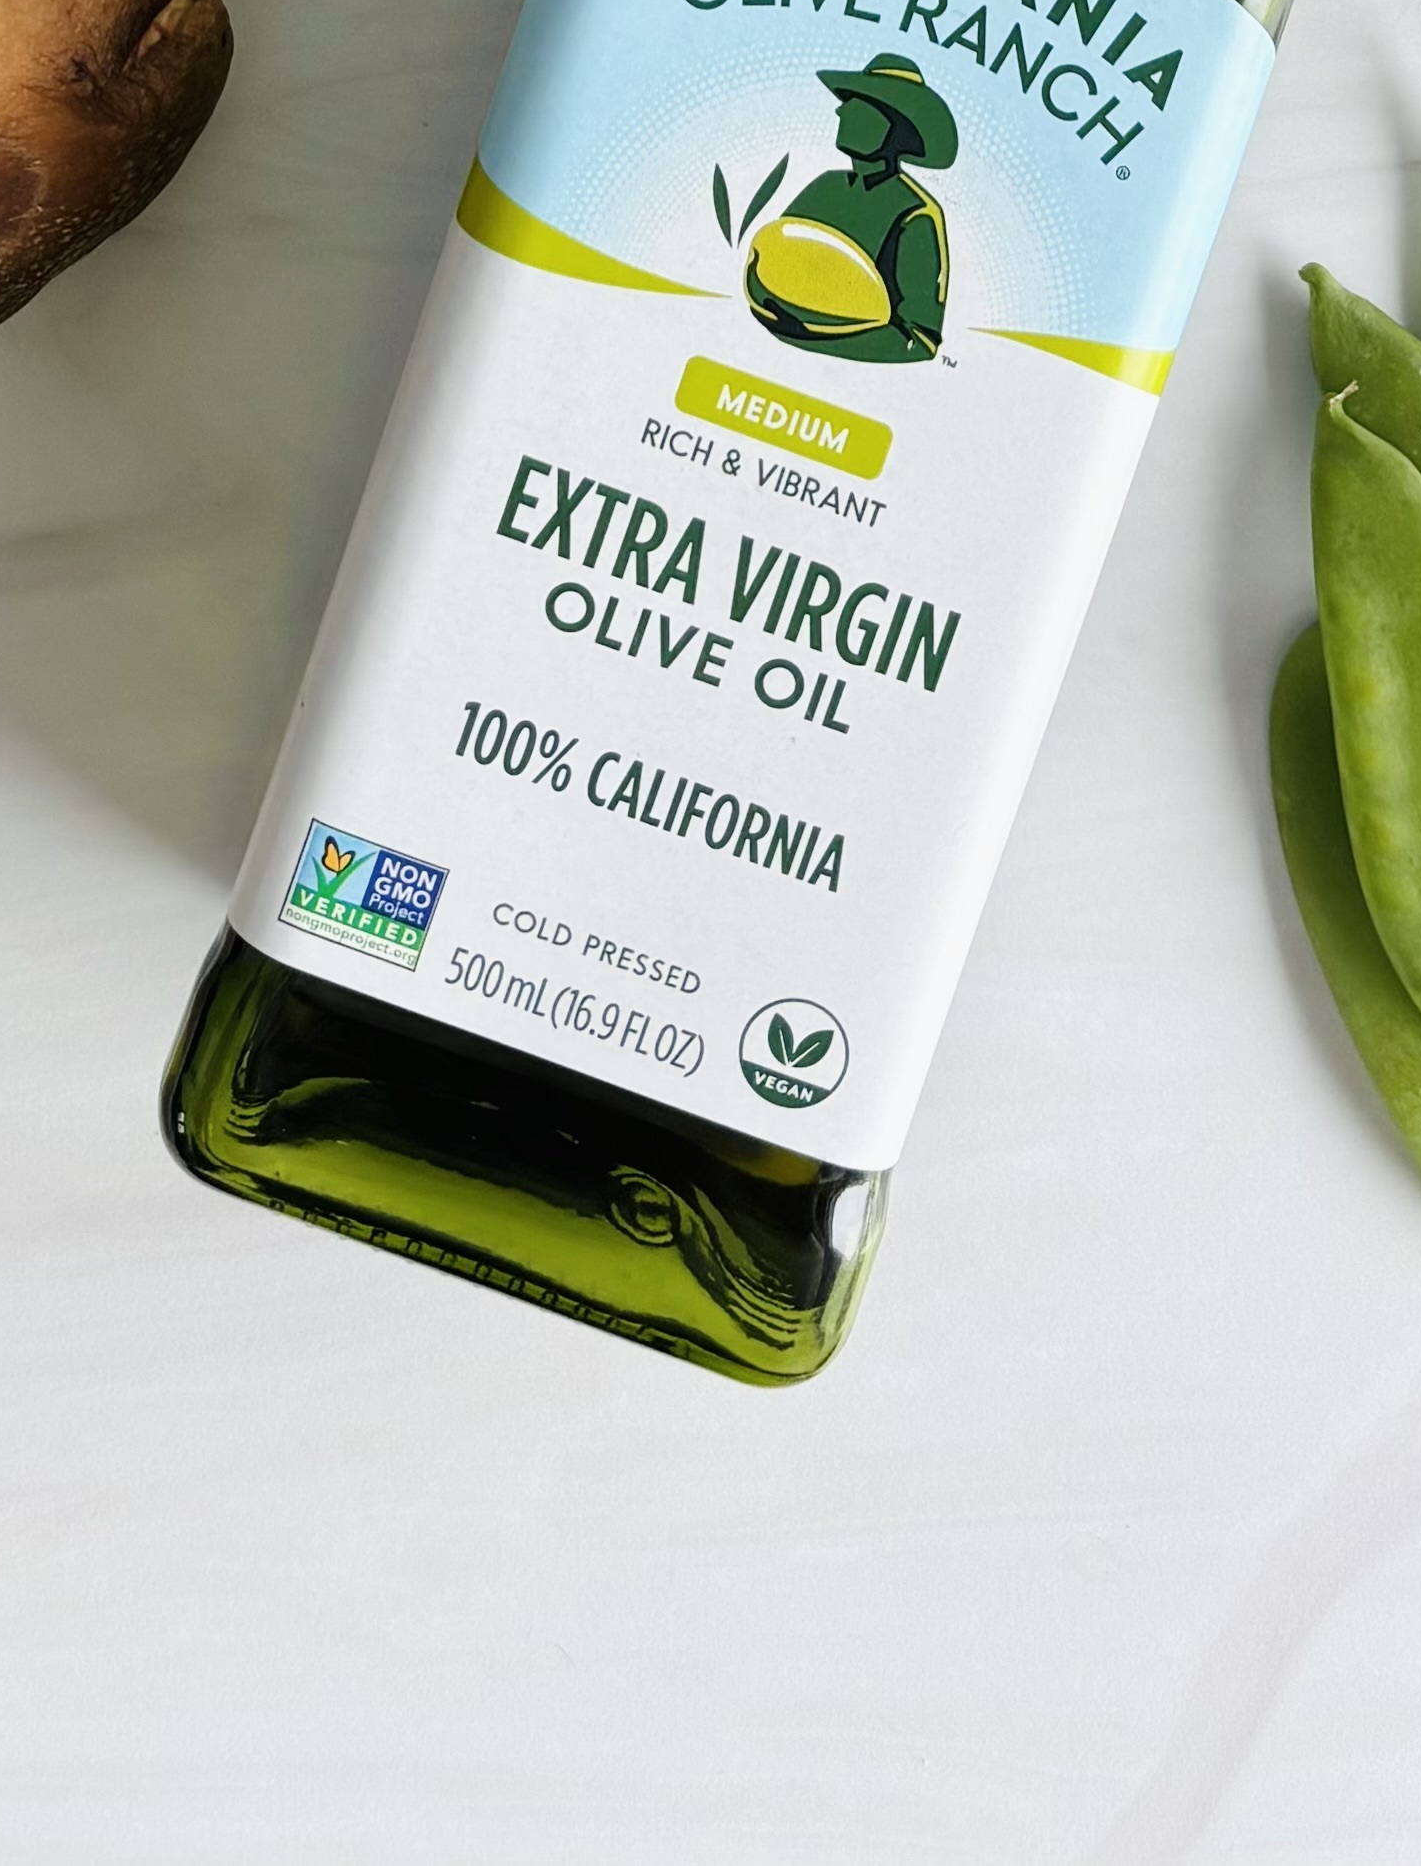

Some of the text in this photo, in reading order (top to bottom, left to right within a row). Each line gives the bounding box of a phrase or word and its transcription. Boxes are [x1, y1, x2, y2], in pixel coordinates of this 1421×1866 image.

[716, 383, 851, 454] MEDIUM
[641, 418, 887, 527] RICH & VIBRANT
[496, 455, 962, 693] EXTRA VIRGIN
[545, 582, 851, 734] OLIVE OIL
[455, 701, 846, 893] 100% CALIFORNIA
[374, 877, 431, 909] GMO
[381, 857, 438, 892] NON
[285, 907, 417, 966] nongmoproject.org
[300, 889, 418, 946] VERIFIED
[368, 893, 424, 926] Project
[493, 903, 701, 994] COLD PRESSED
[754, 1071, 814, 1103] VEGAN
